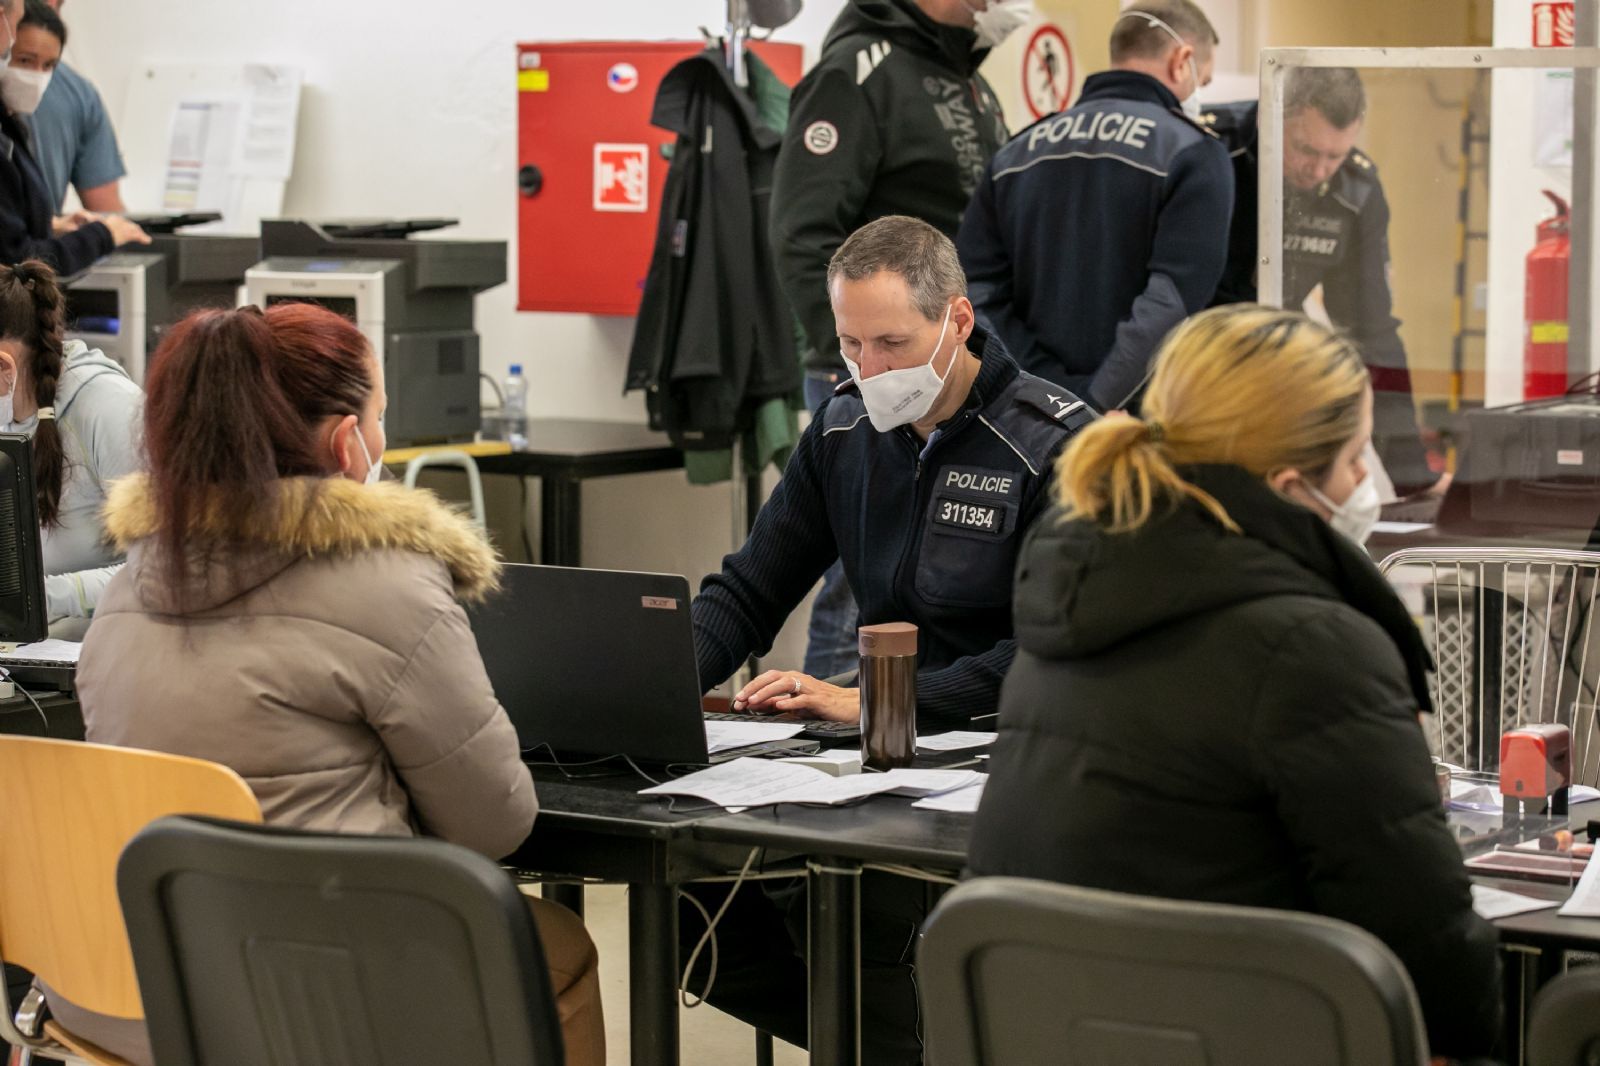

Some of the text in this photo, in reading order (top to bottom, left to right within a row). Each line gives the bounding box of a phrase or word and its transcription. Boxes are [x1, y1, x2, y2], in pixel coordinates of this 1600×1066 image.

[1028, 112, 1157, 151] POLICIE
[945, 471, 1013, 494] POLICIE
[941, 502, 995, 528] 311354
